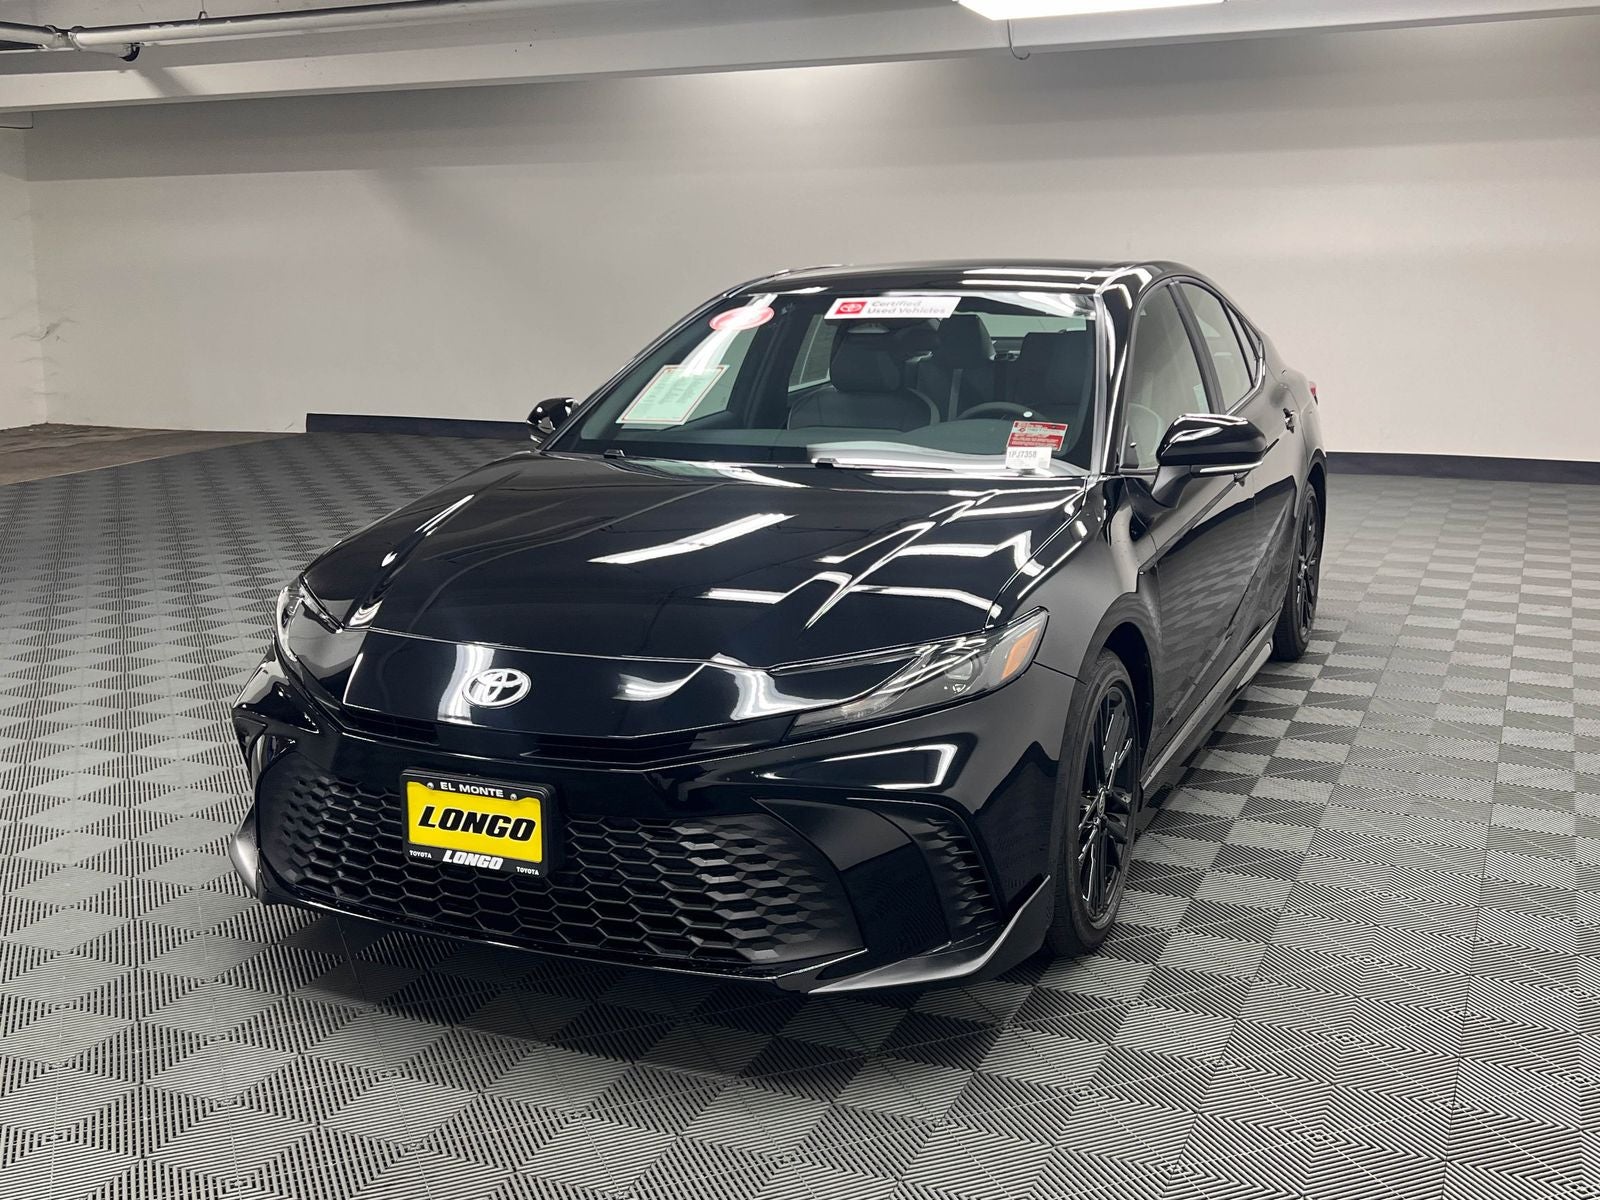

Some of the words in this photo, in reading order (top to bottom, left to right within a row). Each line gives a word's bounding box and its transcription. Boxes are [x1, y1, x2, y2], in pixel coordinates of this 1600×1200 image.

[440, 782, 456, 791] EL
[459, 784, 504, 798] MONTE
[418, 805, 537, 842] LONGO
[409, 850, 432, 859] TOYOTA
[442, 850, 504, 870] LONGO
[516, 866, 540, 876] TOYOTA
